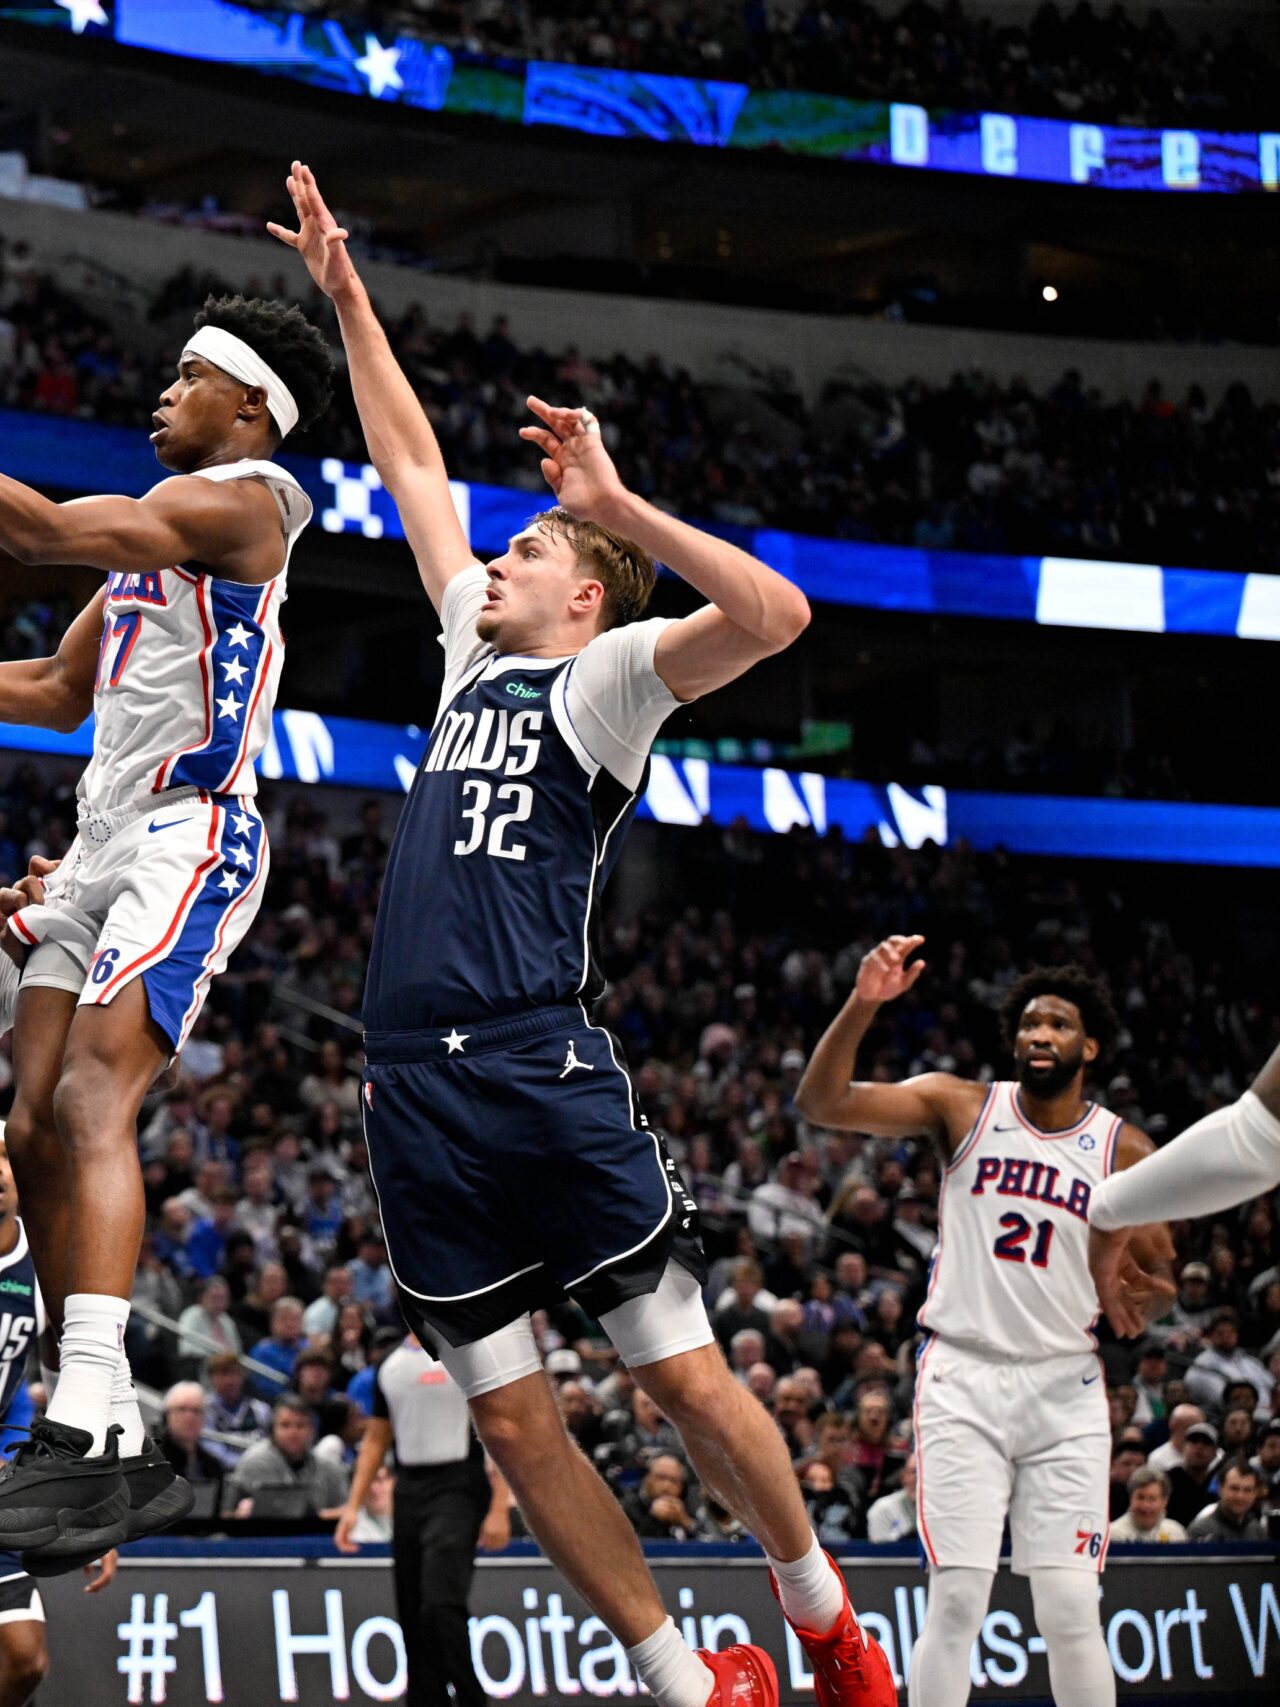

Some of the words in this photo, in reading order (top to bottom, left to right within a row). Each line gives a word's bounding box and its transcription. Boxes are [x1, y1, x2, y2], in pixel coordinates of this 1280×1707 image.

[453, 779, 533, 861] 32
[993, 1211, 1054, 1268] 21
[1073, 1529, 1102, 1558] 76
[117, 1591, 224, 1704] #1
